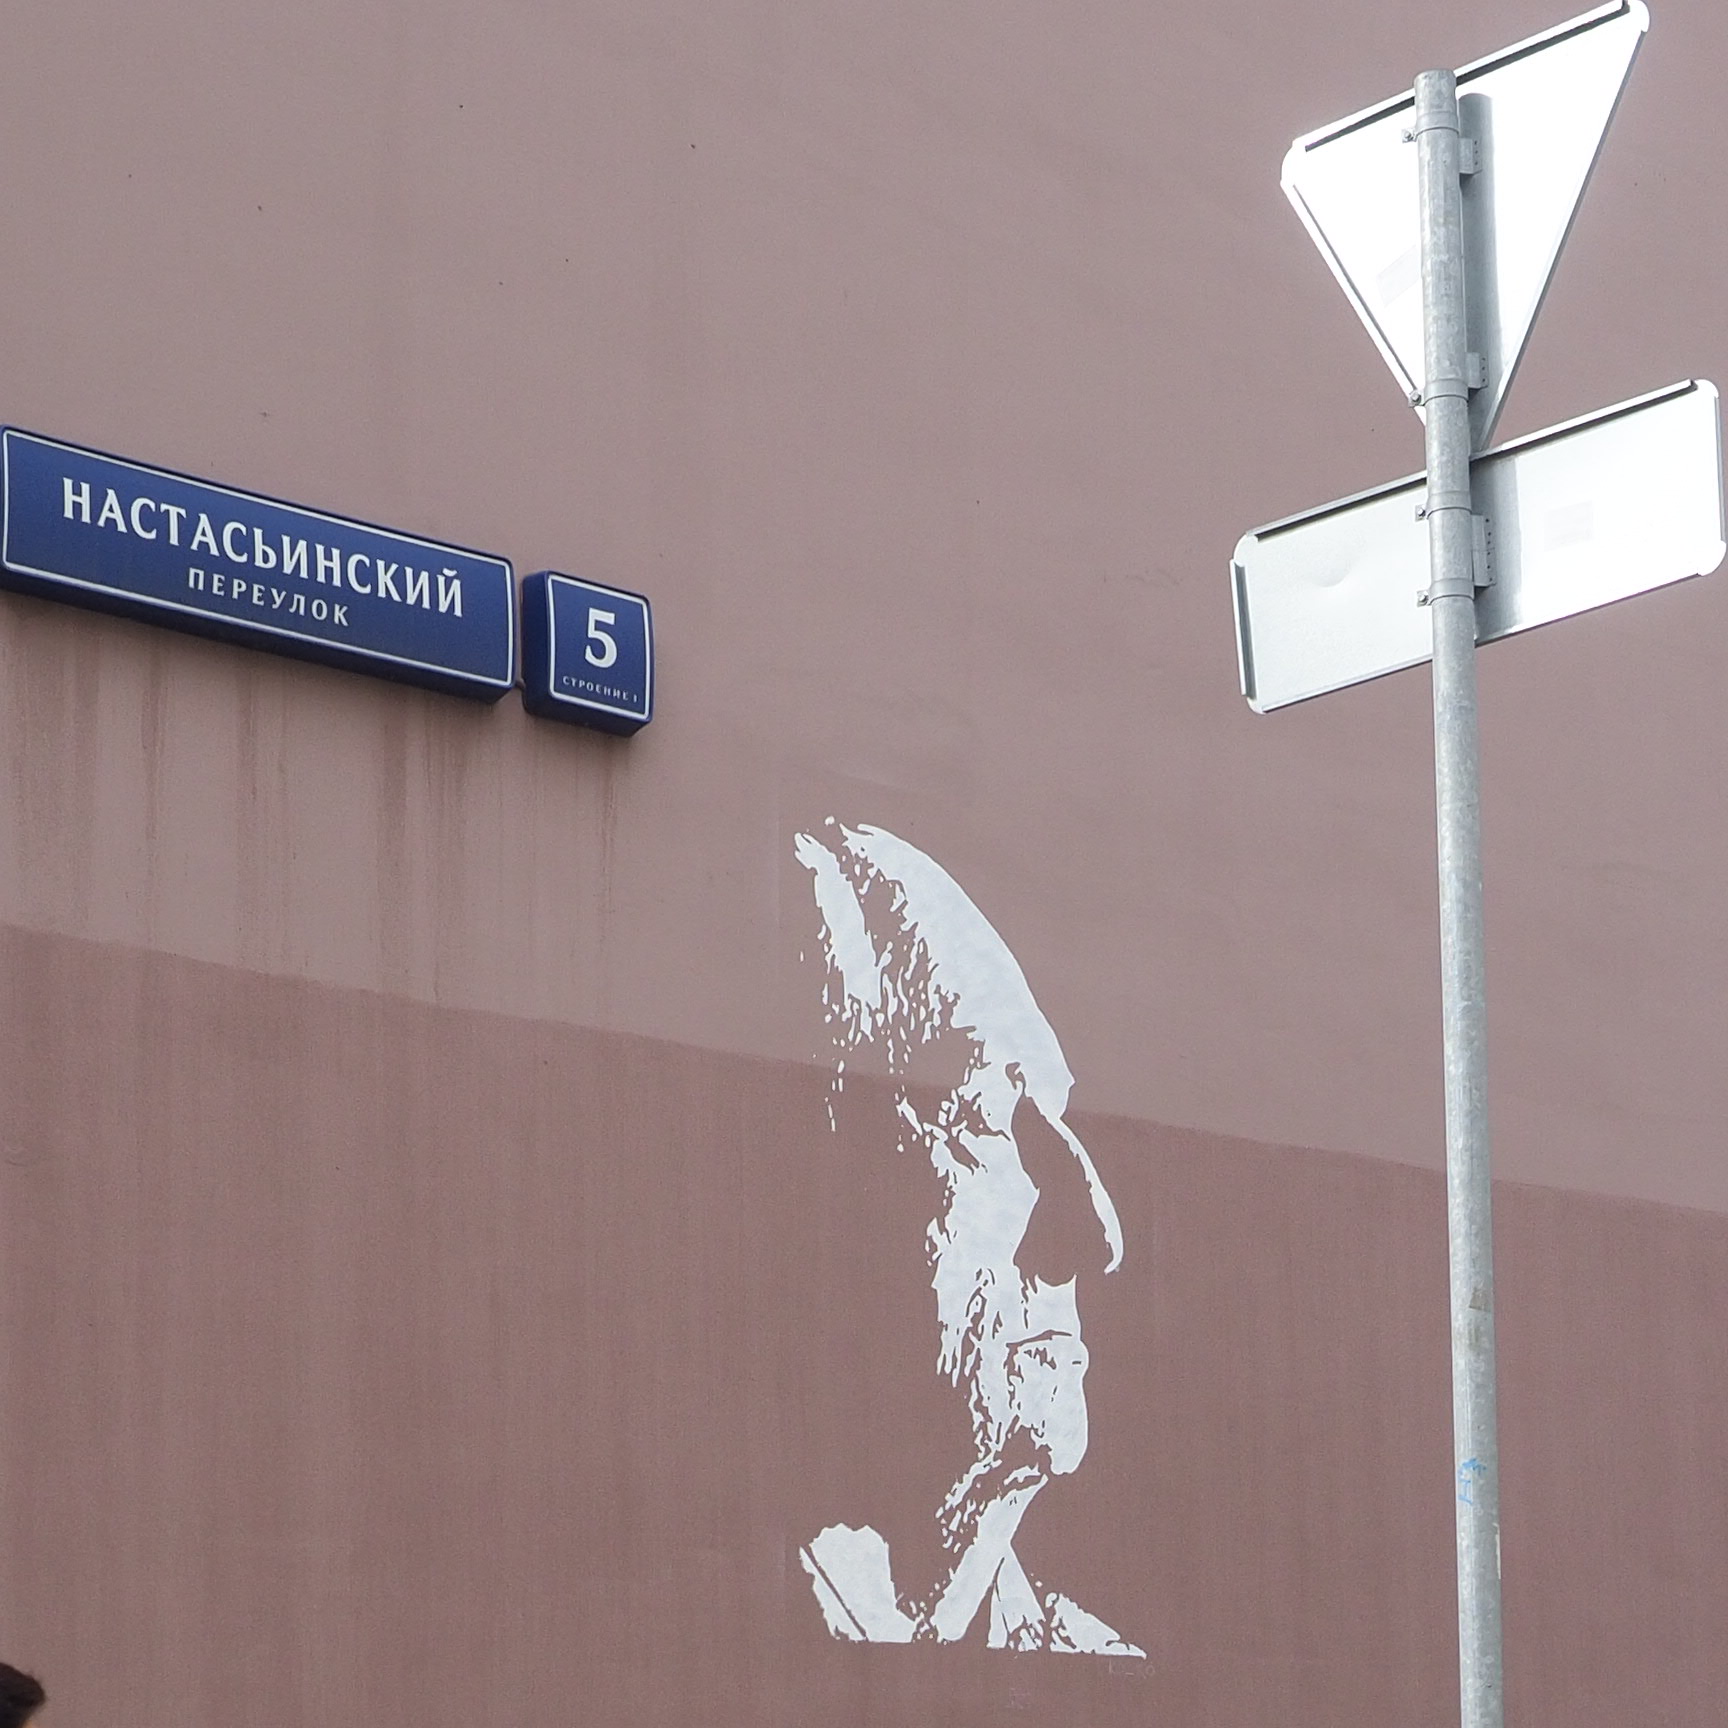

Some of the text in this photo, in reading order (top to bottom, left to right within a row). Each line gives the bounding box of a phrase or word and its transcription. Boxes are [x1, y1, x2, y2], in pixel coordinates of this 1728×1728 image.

[61, 476, 464, 618] НАСТАСЬИНСКИЙ
[187, 566, 351, 628] ПЕРЕУЛОК
[584, 607, 618, 669] 5
[562, 675, 629, 701] СТРОЕНИЕ
